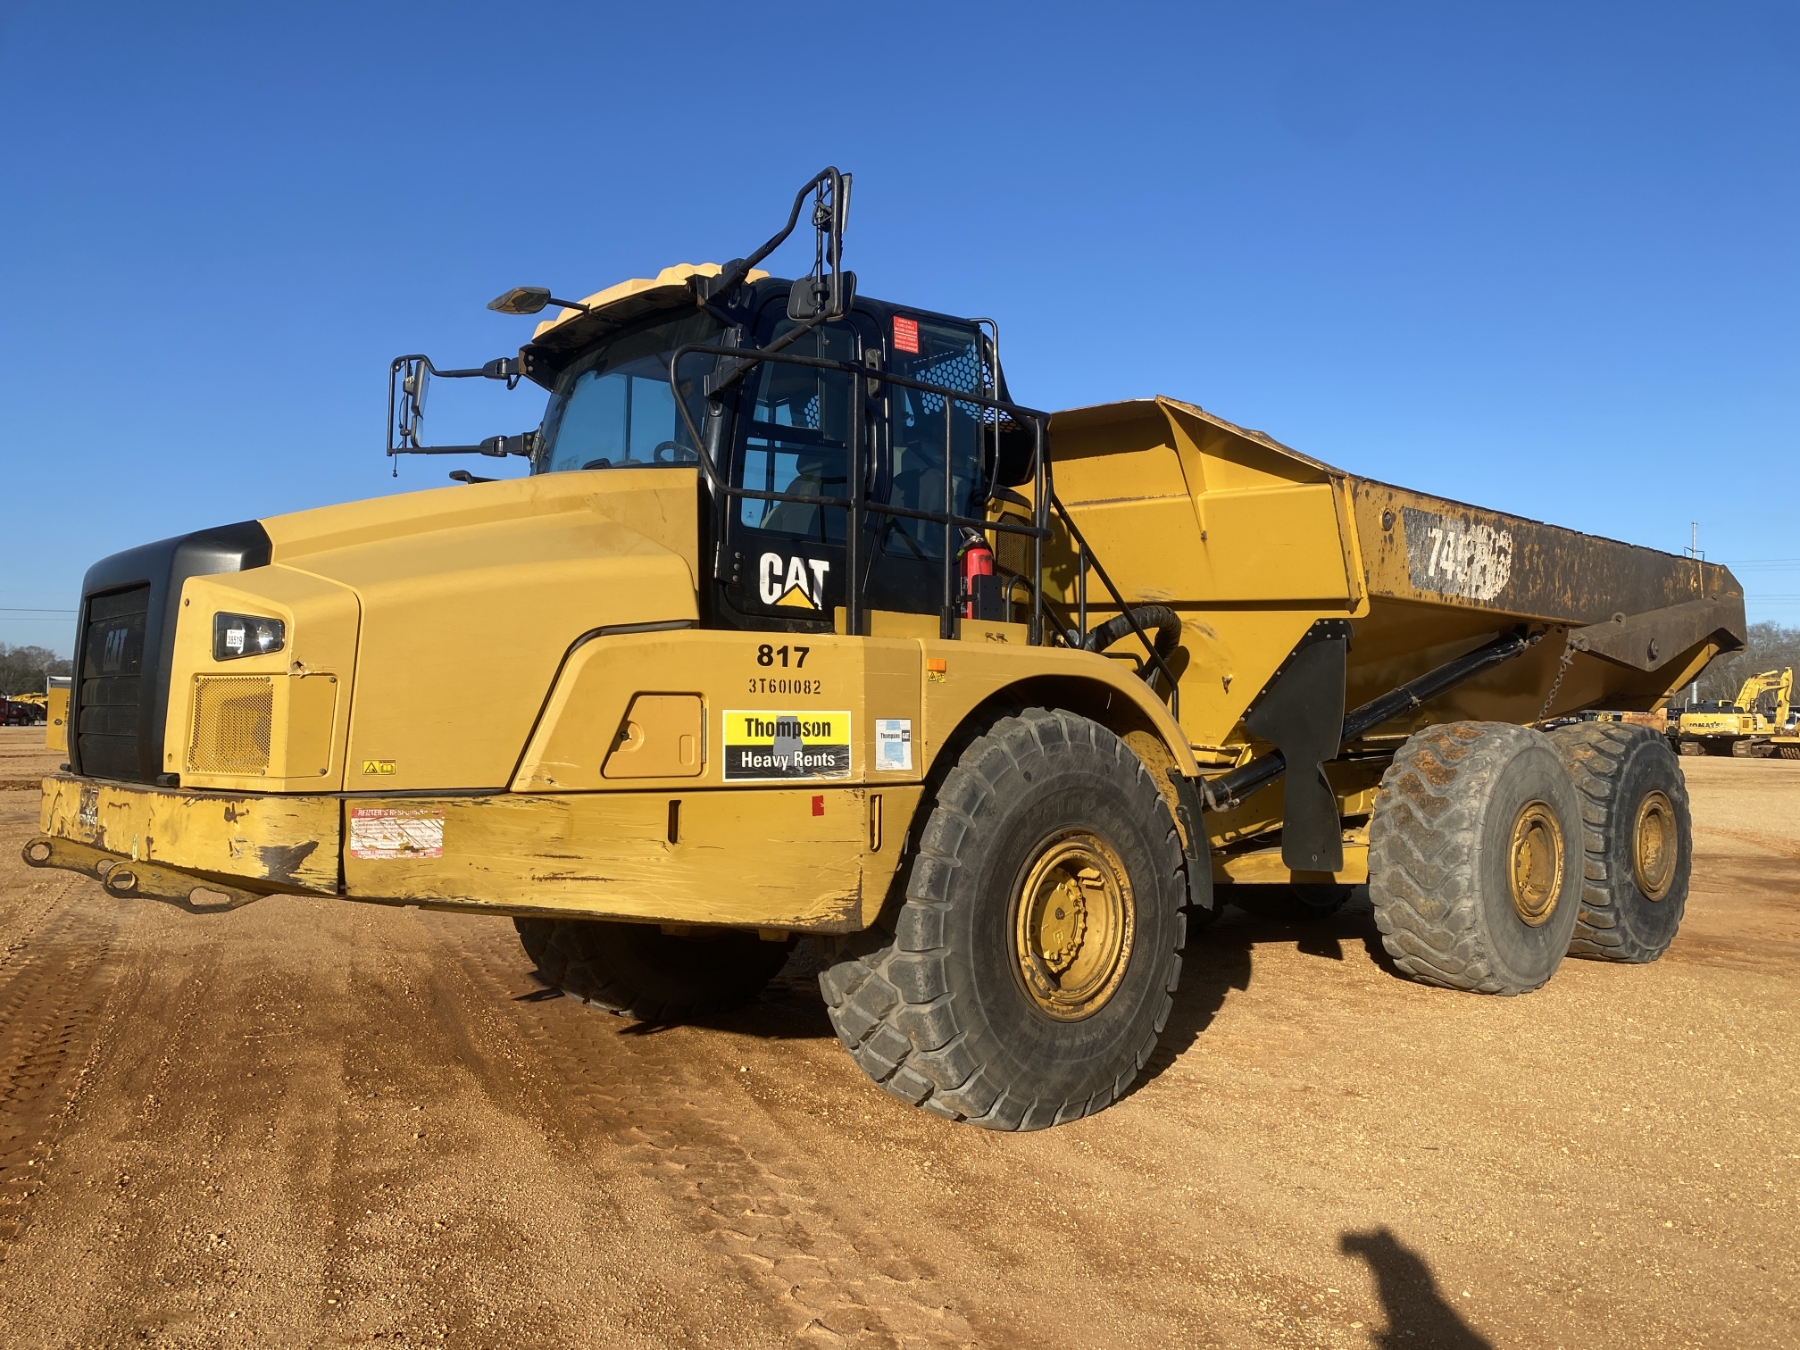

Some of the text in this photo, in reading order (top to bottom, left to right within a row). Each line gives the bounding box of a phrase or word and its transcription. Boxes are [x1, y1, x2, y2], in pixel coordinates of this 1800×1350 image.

[759, 552, 829, 611] CAT
[757, 644, 810, 668] 817
[744, 718, 831, 739] Thompson
[741, 750, 836, 771] Heavy Rents
